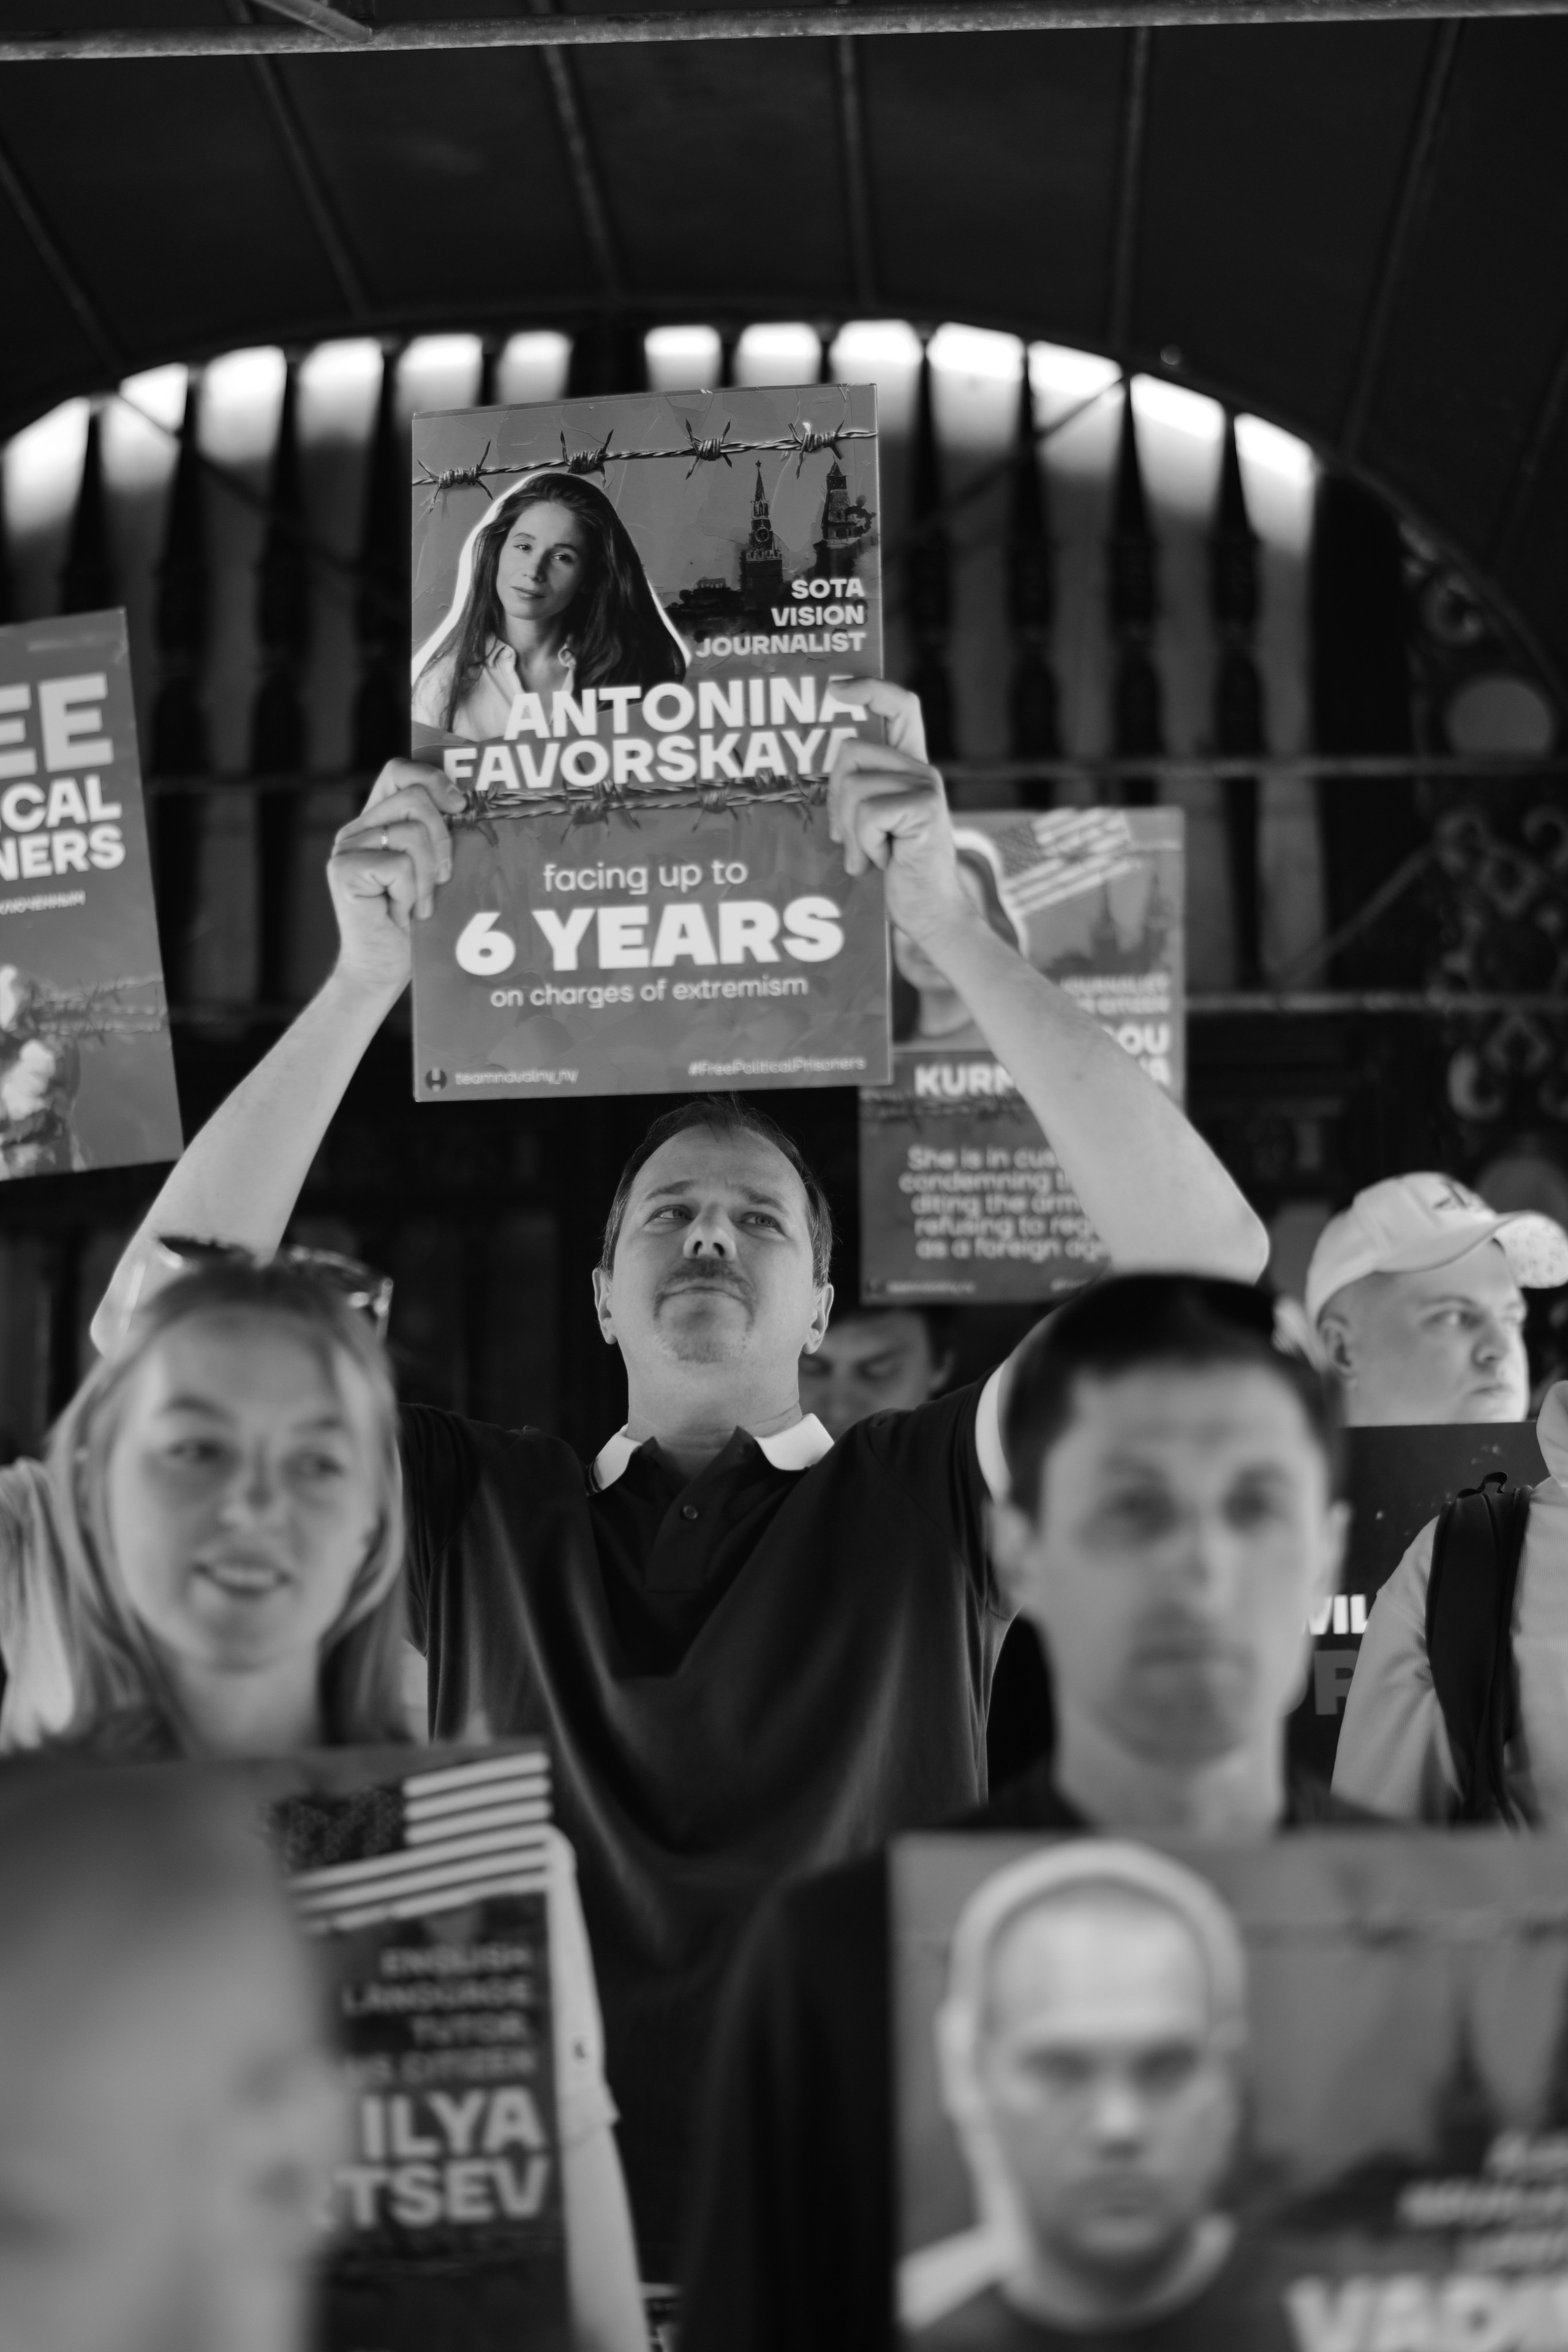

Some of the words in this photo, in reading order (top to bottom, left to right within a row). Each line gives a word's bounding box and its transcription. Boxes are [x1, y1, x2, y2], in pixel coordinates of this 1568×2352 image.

[791, 578, 865, 601] SOTA
[771, 605, 864, 627] VISION
[696, 632, 866, 659] JOURNALIST
[503, 675, 867, 741] ANTONINA
[543, 862, 648, 895] facing
[658, 865, 703, 892] up
[712, 859, 748, 884] to
[455, 911, 516, 976] 6
[532, 895, 845, 971] YEARS
[491, 987, 524, 1008] on
[529, 981, 634, 1009] charges
[640, 979, 668, 1003] of
[672, 975, 808, 1000] extremism
[688, 1056, 866, 1077] #FreePoliticalPrisoners
[363, 2086, 544, 2161] ILYA
